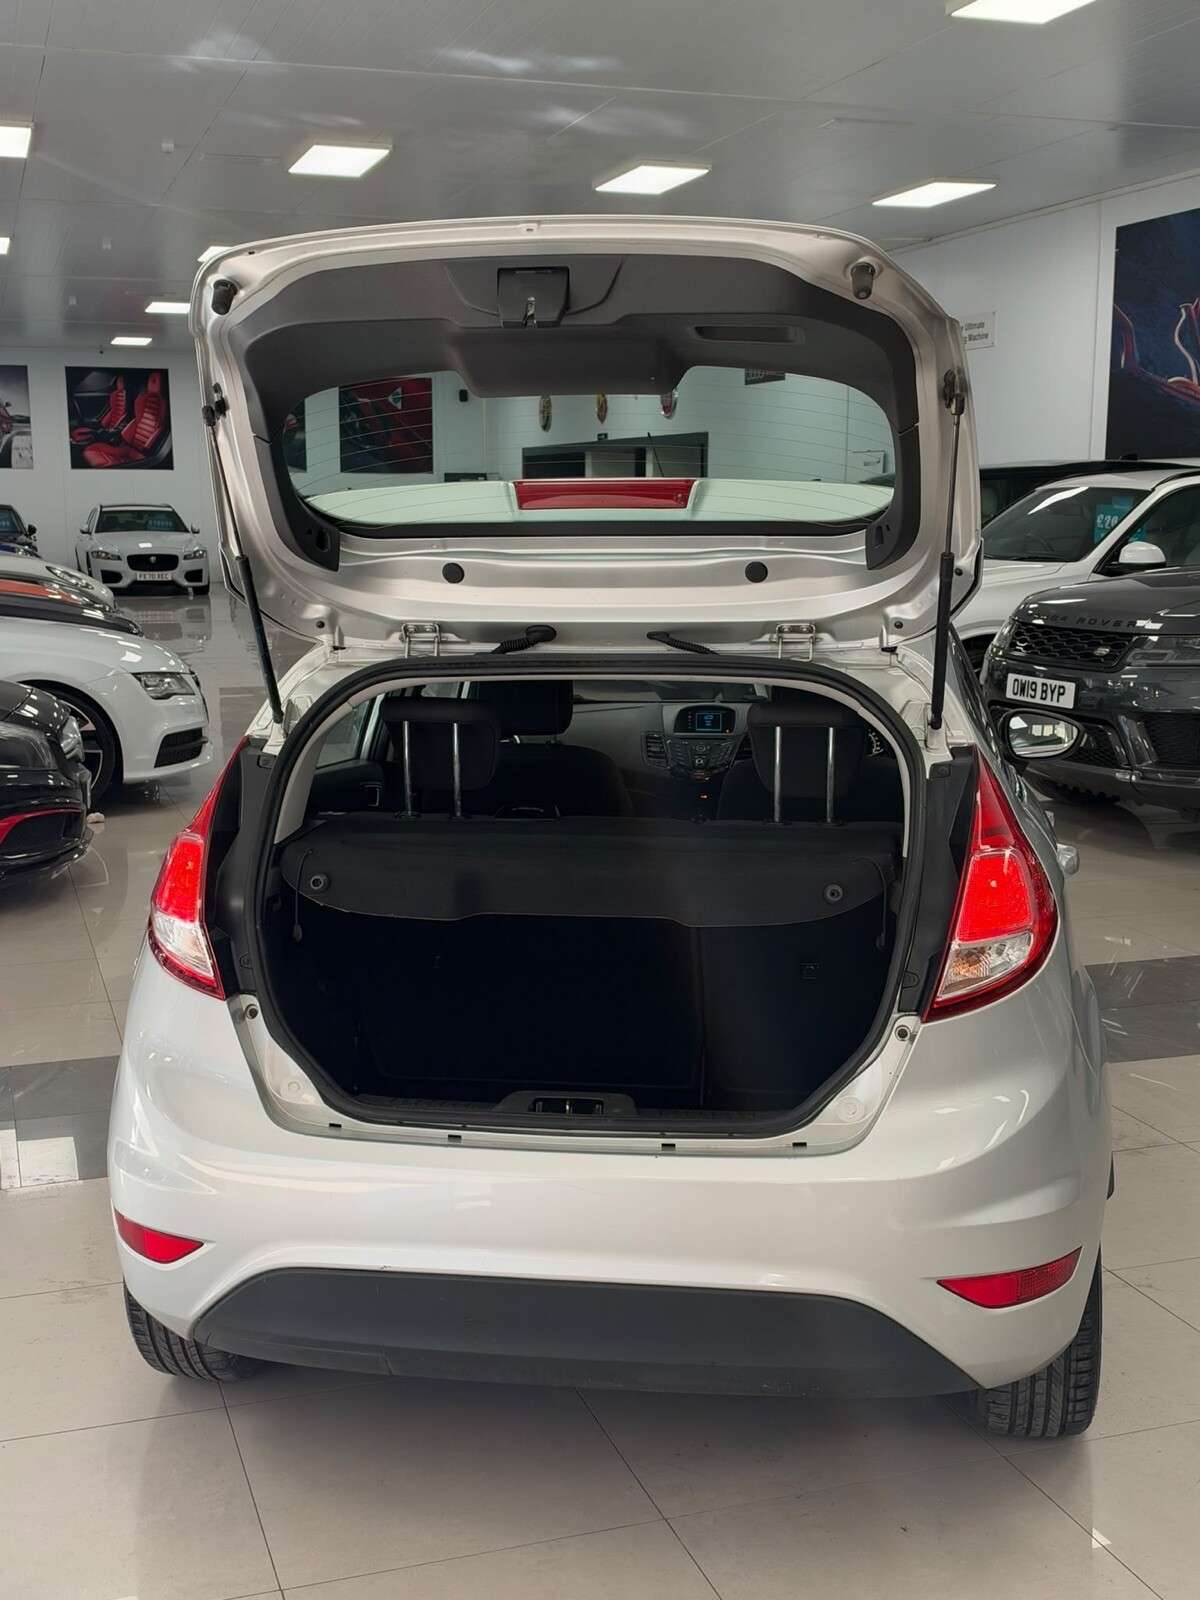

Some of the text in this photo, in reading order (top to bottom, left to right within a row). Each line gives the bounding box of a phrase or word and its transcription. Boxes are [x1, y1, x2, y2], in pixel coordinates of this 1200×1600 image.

[1075, 616, 1137, 628] ROVER
[1012, 679, 1066, 703] OW19 BYP
